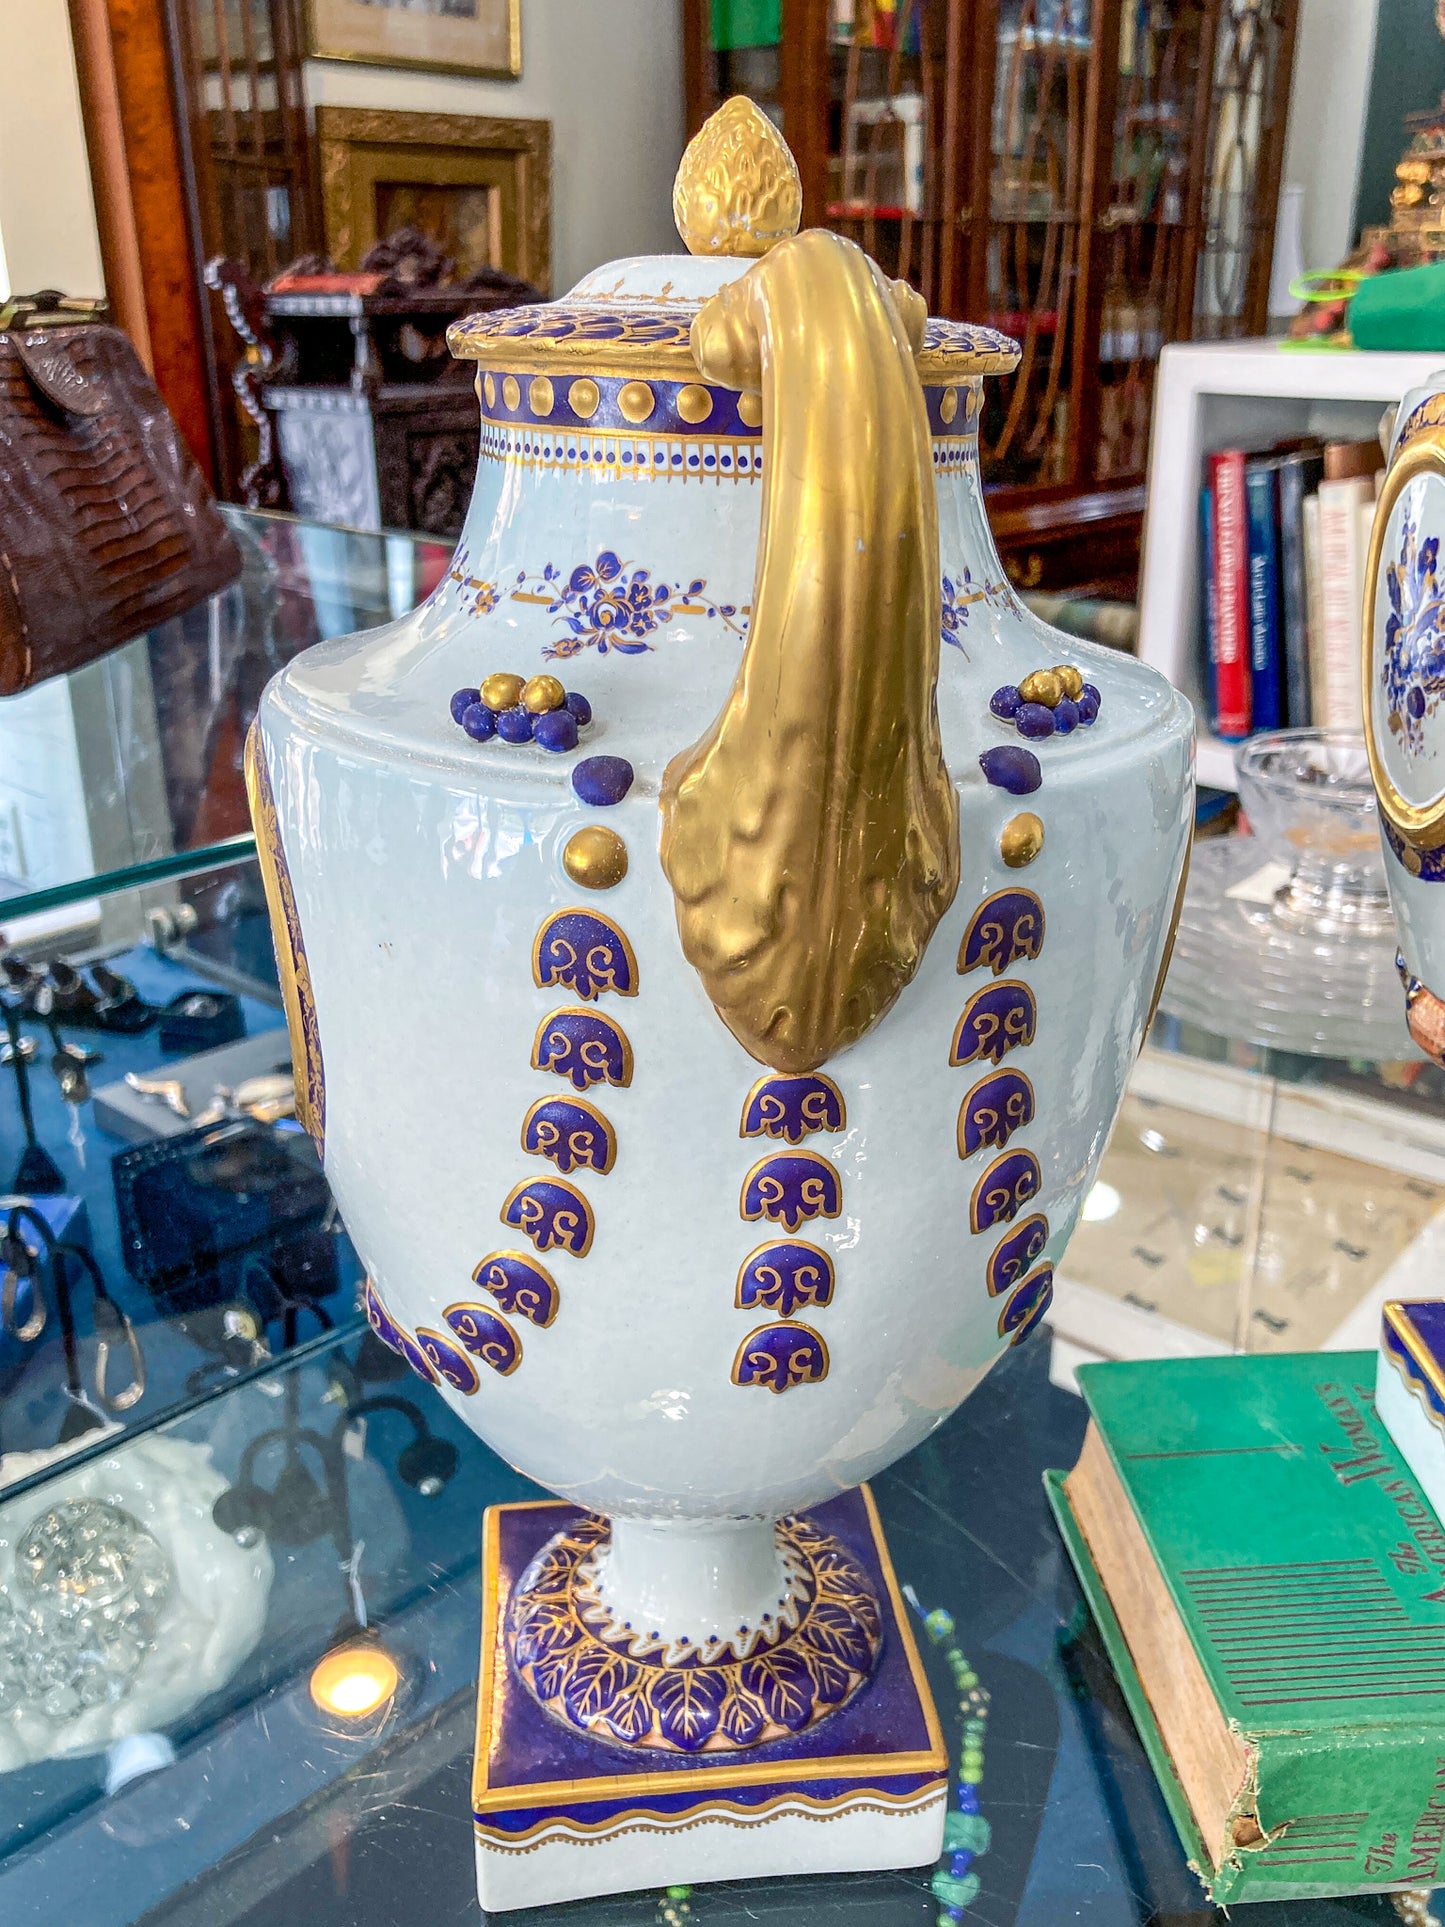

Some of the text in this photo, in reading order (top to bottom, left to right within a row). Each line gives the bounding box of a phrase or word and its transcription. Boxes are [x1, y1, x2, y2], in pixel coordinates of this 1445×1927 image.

[1378, 1479, 1445, 1602] AERICAN
[1387, 1541, 1428, 1575] The
[1364, 1833, 1398, 1875] The
